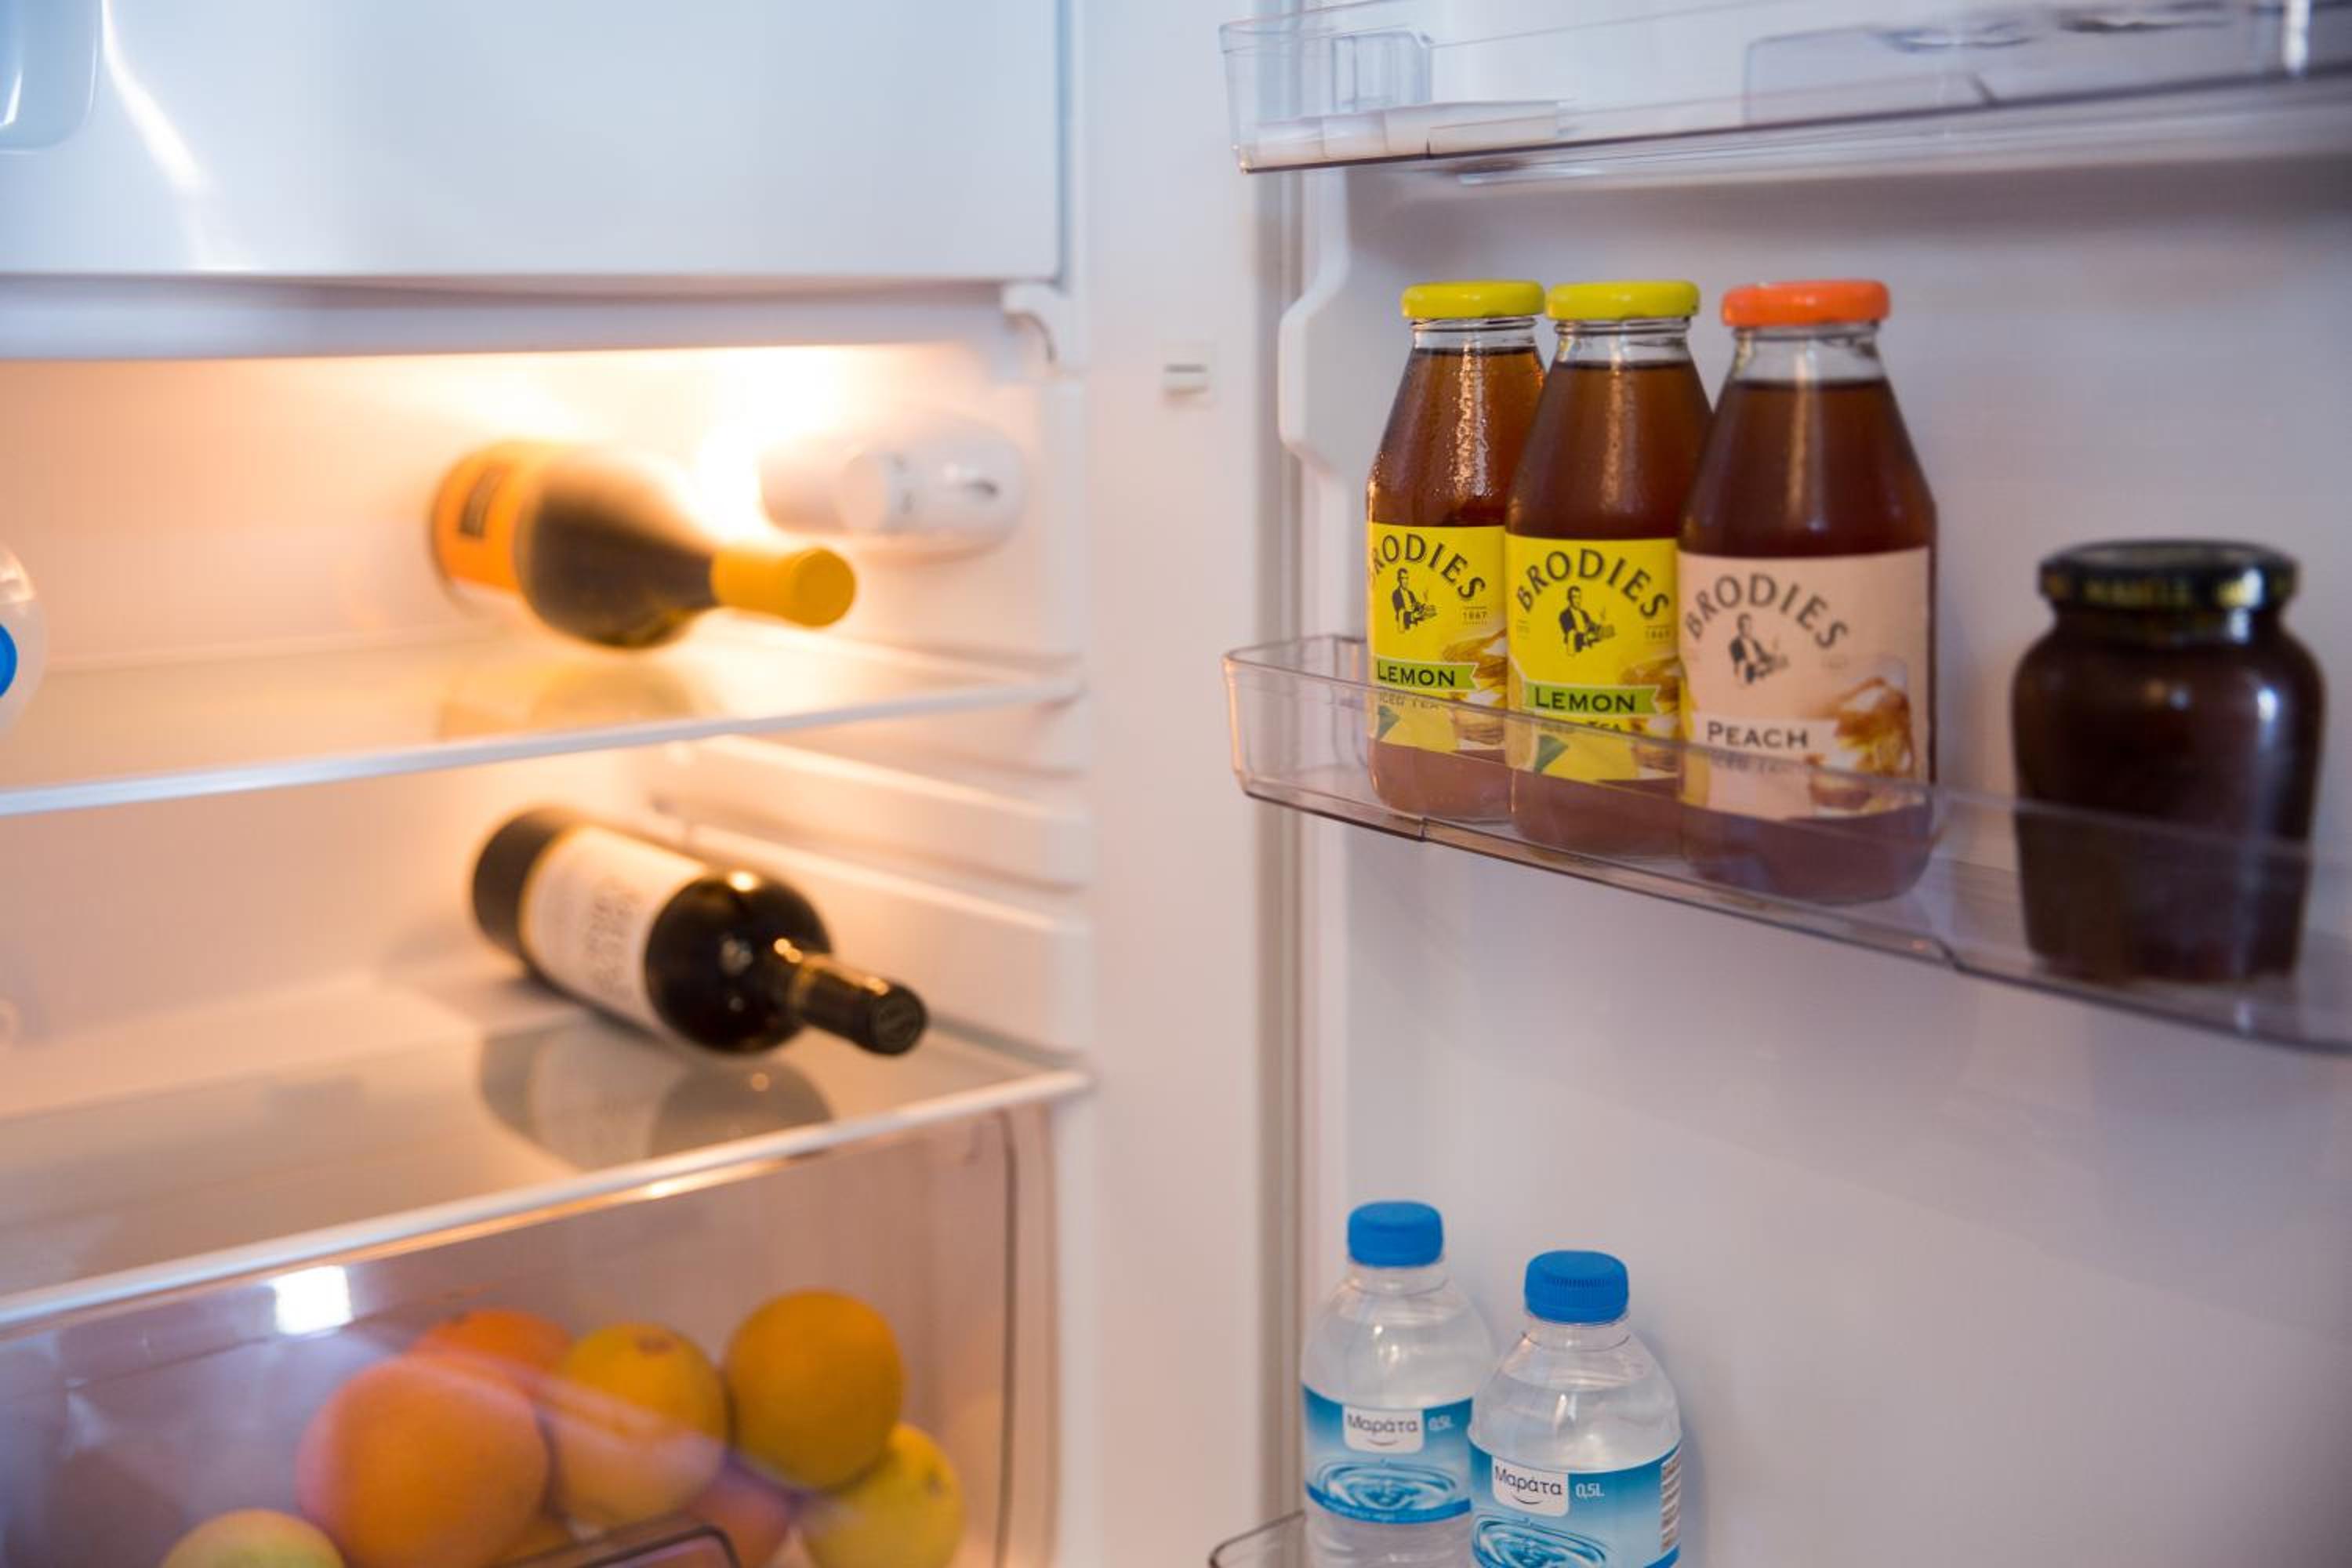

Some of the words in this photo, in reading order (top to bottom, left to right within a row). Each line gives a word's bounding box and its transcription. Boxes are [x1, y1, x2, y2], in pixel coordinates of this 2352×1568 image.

[1516, 547, 1669, 620] BRODIES
[1685, 572, 1849, 649] BRODIES
[1377, 659, 1455, 687] LEMON
[1535, 687, 1635, 713] LEMON
[1707, 720, 1809, 748] PEACH
[1347, 1414, 1418, 1435] Μαράτα
[1494, 1465, 1563, 1497] Μαράτα
